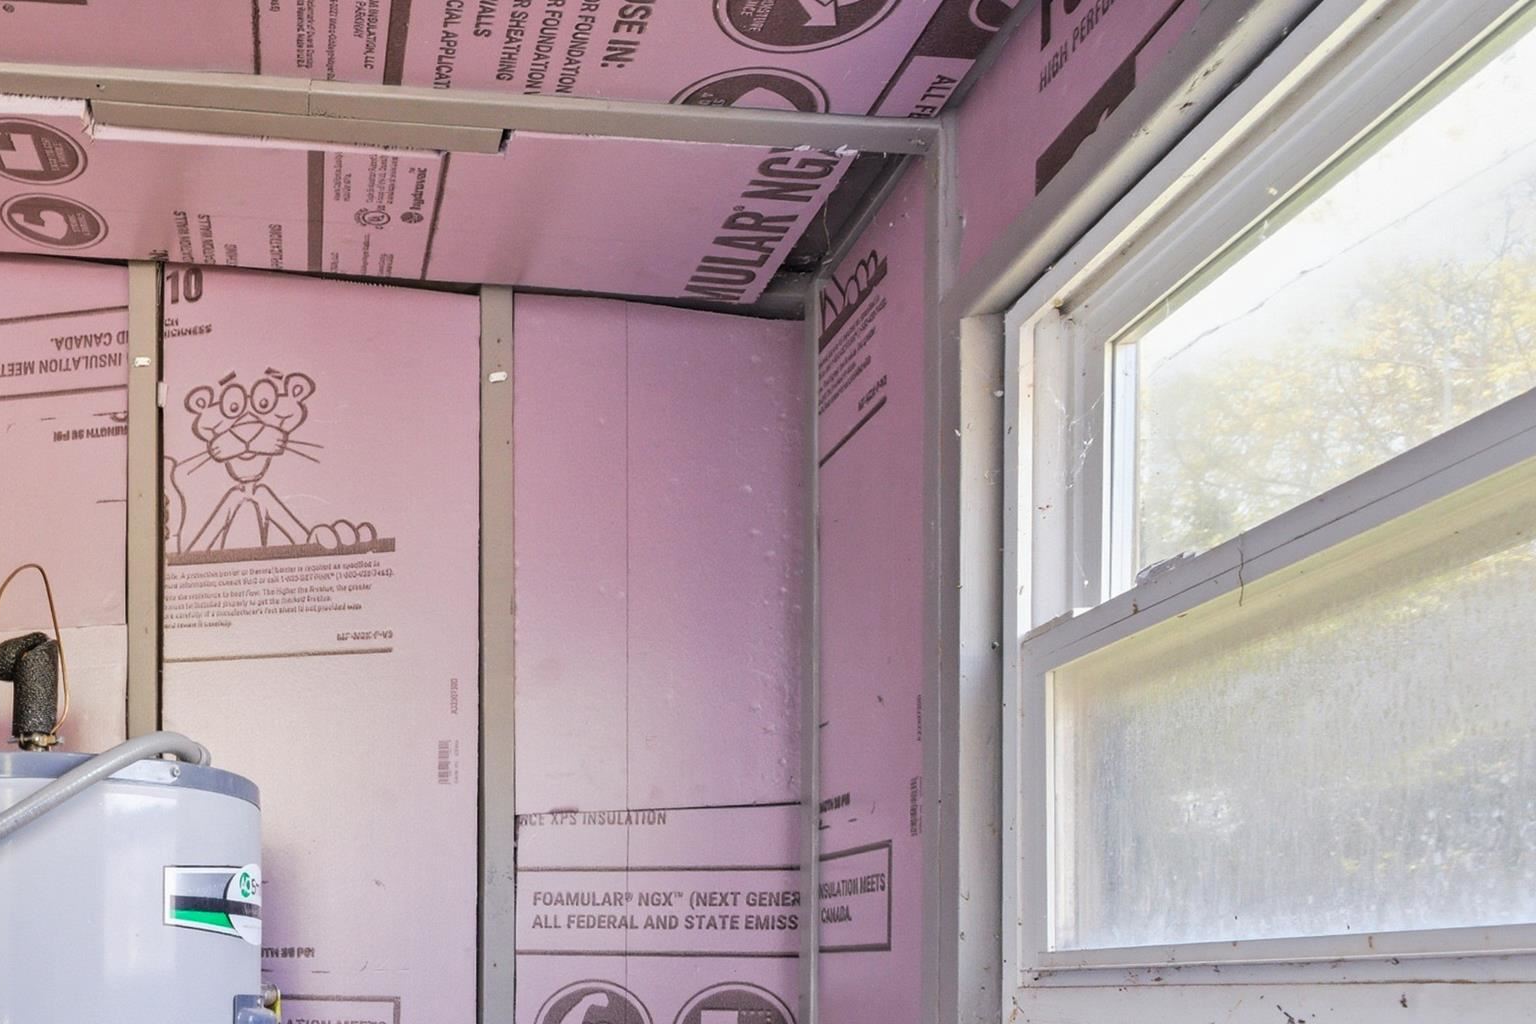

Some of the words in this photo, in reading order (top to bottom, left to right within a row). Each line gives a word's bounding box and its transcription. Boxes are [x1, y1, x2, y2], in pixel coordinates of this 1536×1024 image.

[496, 10, 530, 82] SHEATHING
[528, 13, 562, 92] FOUNDATION
[555, 12, 597, 95] FOUNDATION
[601, 38, 640, 69] IN:
[1039, 40, 1069, 93] HIGH
[918, 74, 959, 104] ALL
[50, 331, 113, 351] CANADA.
[38, 352, 122, 375] INSULATION
[551, 811, 577, 826] XPS
[582, 810, 667, 826] INSULATION
[859, 872, 886, 894] MEETS
[689, 889, 740, 909] (NEXT
[531, 914, 562, 930] ALL
[566, 914, 639, 930] FEDERAL
[643, 914, 679, 930] AND
[684, 913, 740, 930] STATE
[820, 905, 852, 923] CANADA.
